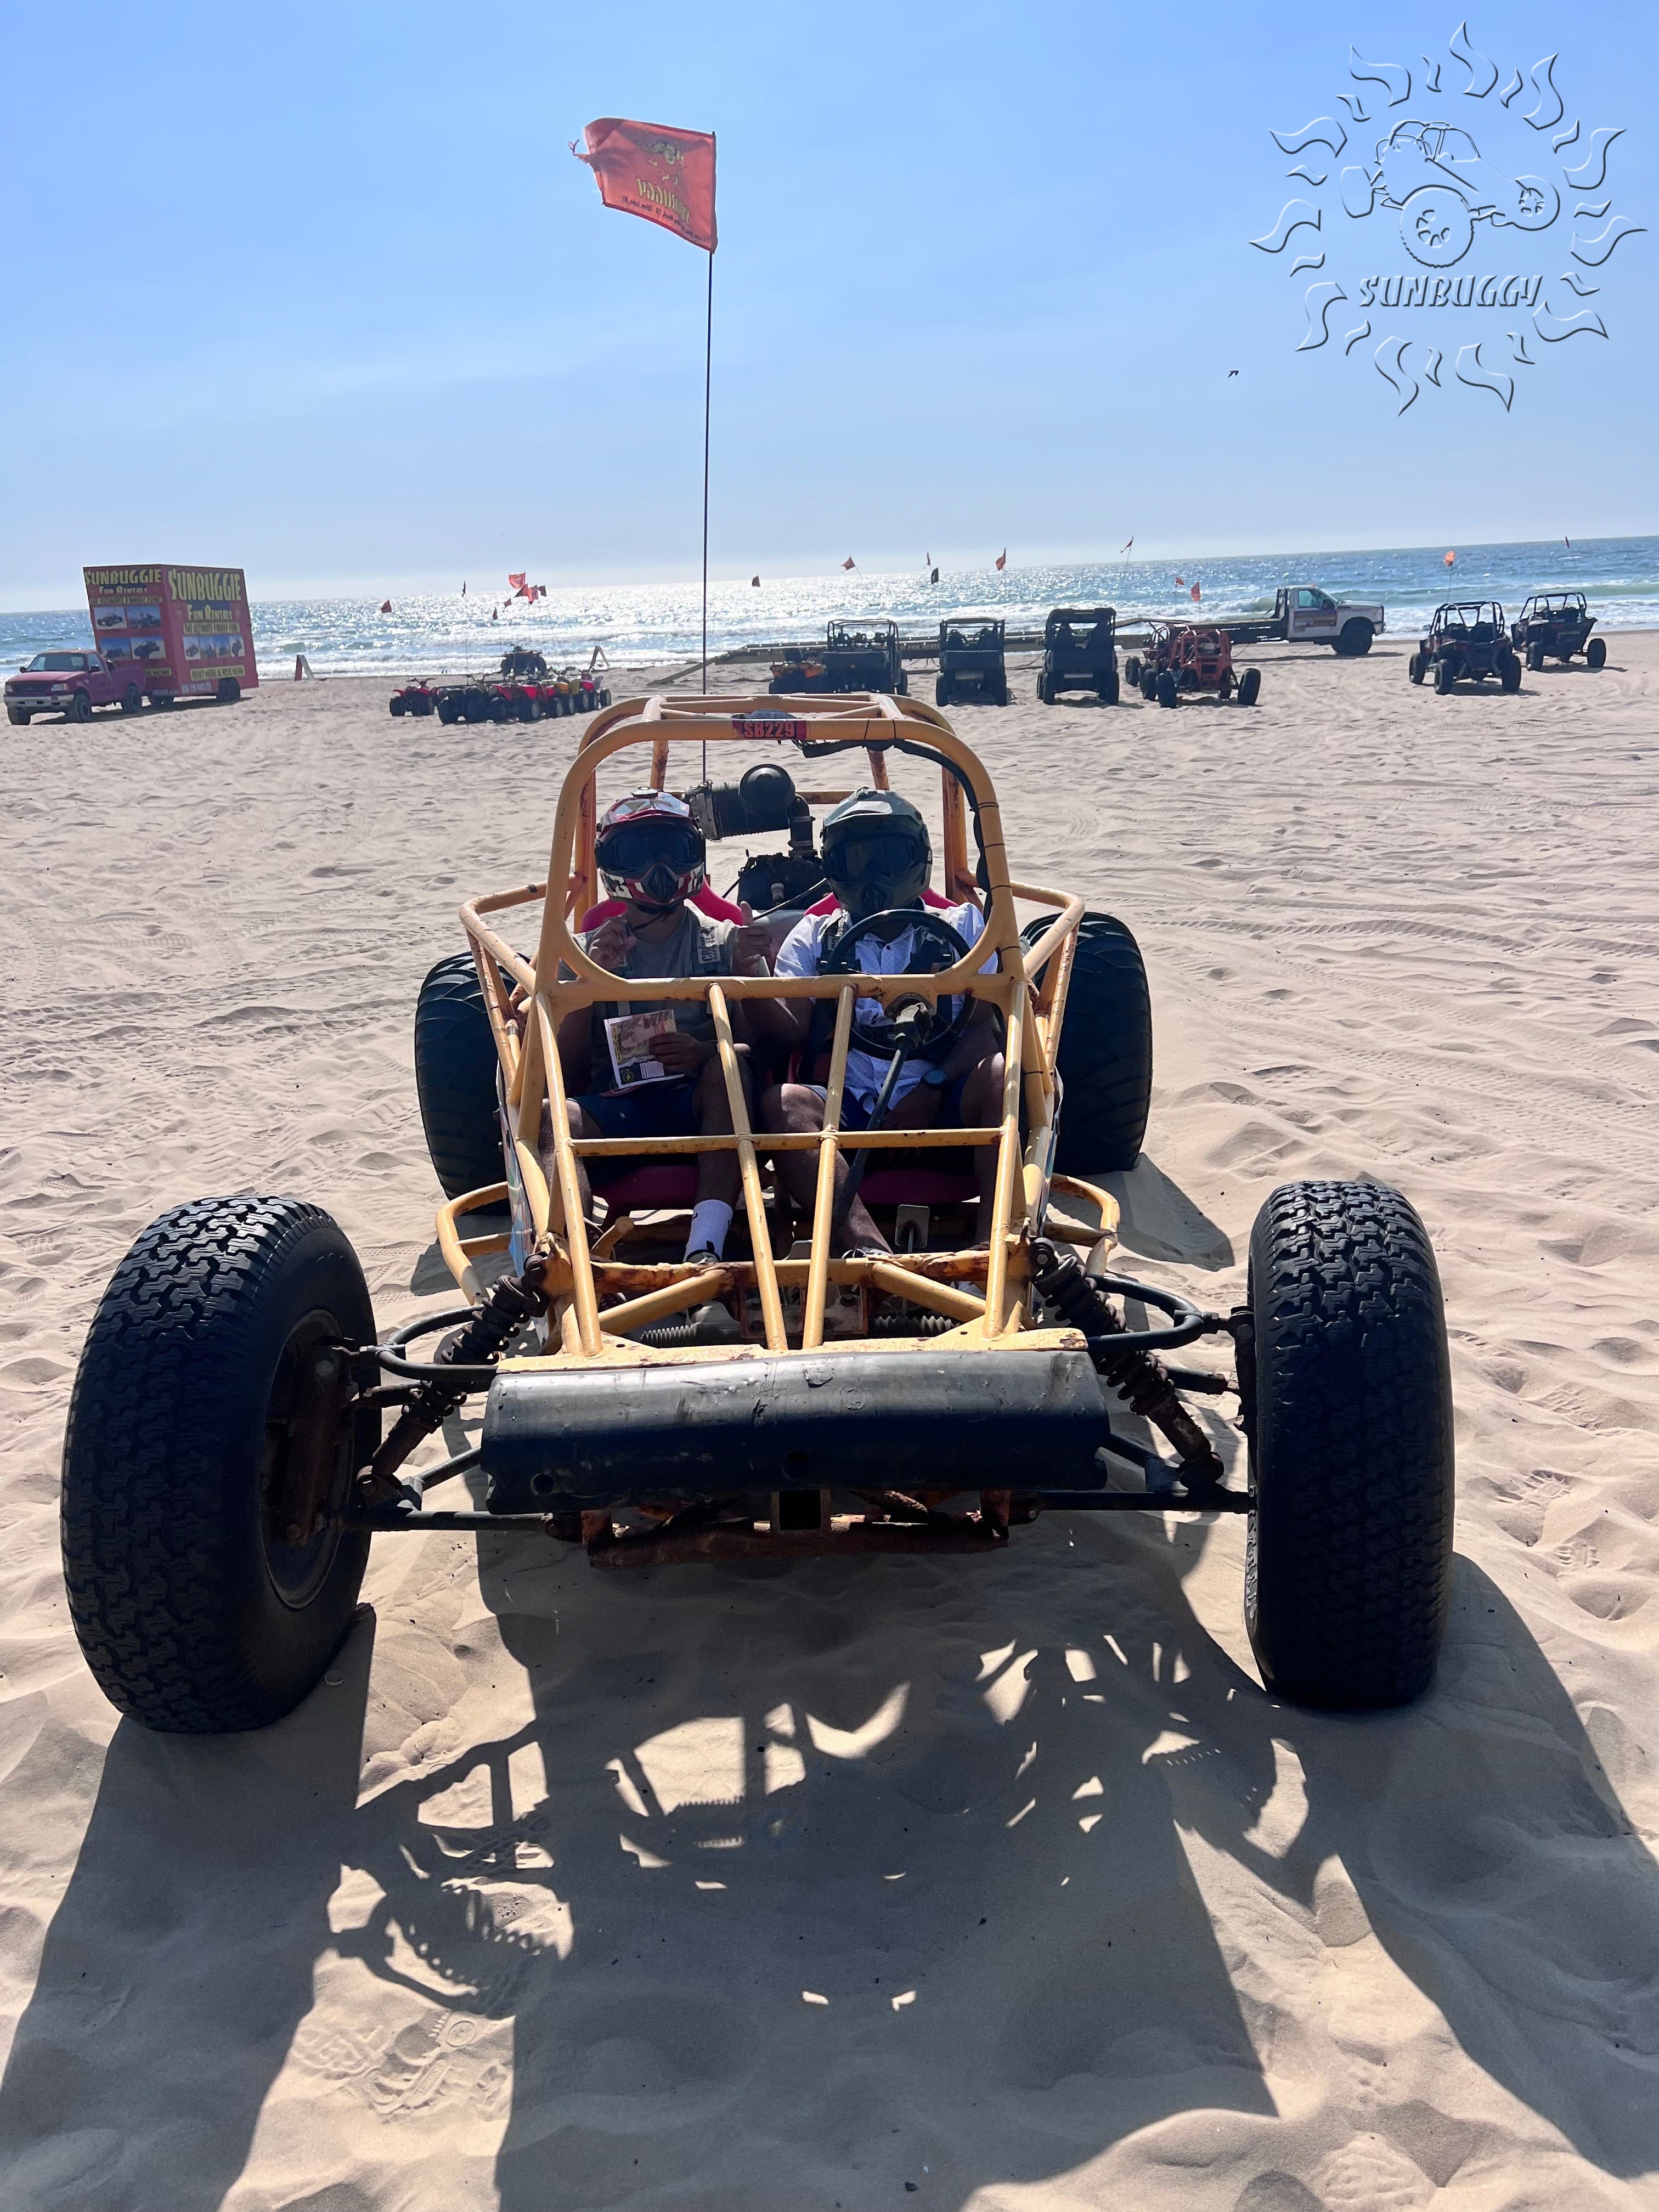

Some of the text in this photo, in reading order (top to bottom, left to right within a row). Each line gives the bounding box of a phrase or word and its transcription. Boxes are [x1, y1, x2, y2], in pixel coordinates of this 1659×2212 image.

[84, 568, 161, 585] SUNBUGGIE
[168, 568, 241, 601] SUNBUGGIE
[743, 721, 795, 738] SB229
